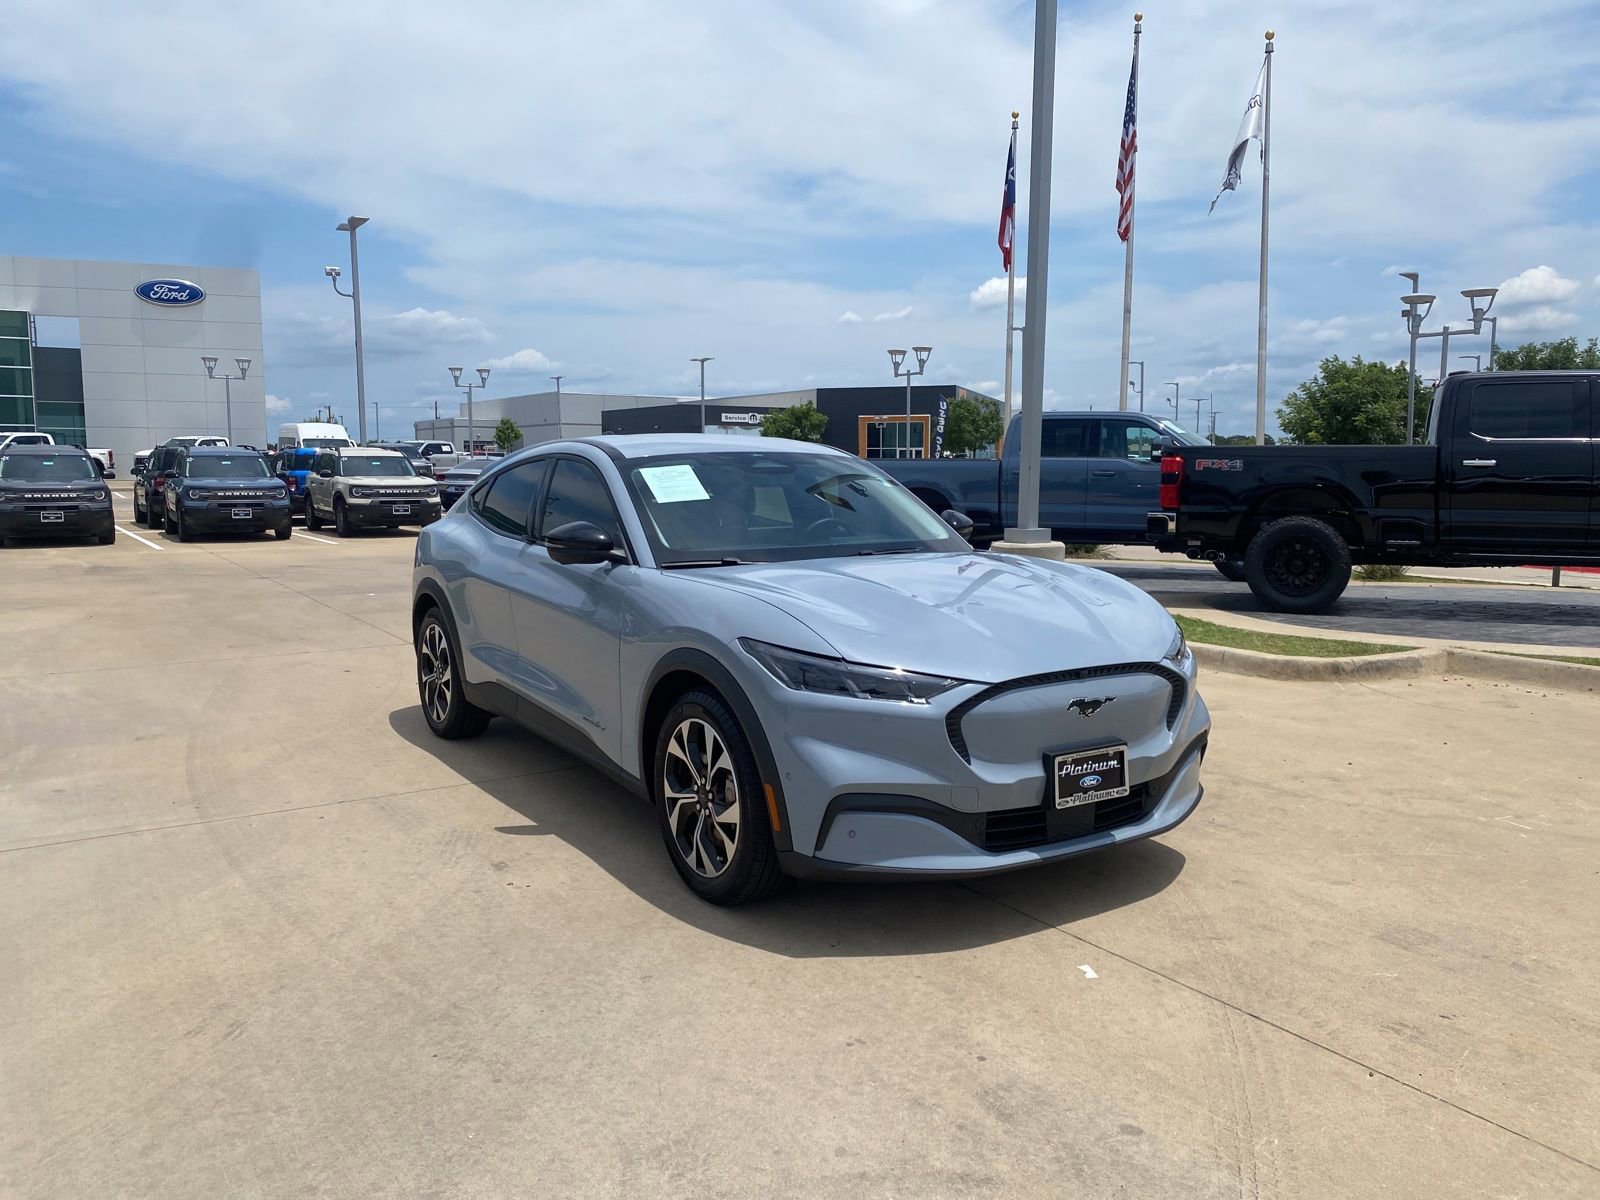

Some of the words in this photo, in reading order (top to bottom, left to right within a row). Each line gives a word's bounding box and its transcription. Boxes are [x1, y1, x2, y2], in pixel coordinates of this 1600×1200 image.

[150, 284, 190, 300] Ford
[1195, 459, 1243, 471] FX4
[1059, 760, 1121, 777] Platinum
[1073, 790, 1115, 804] Platinum
